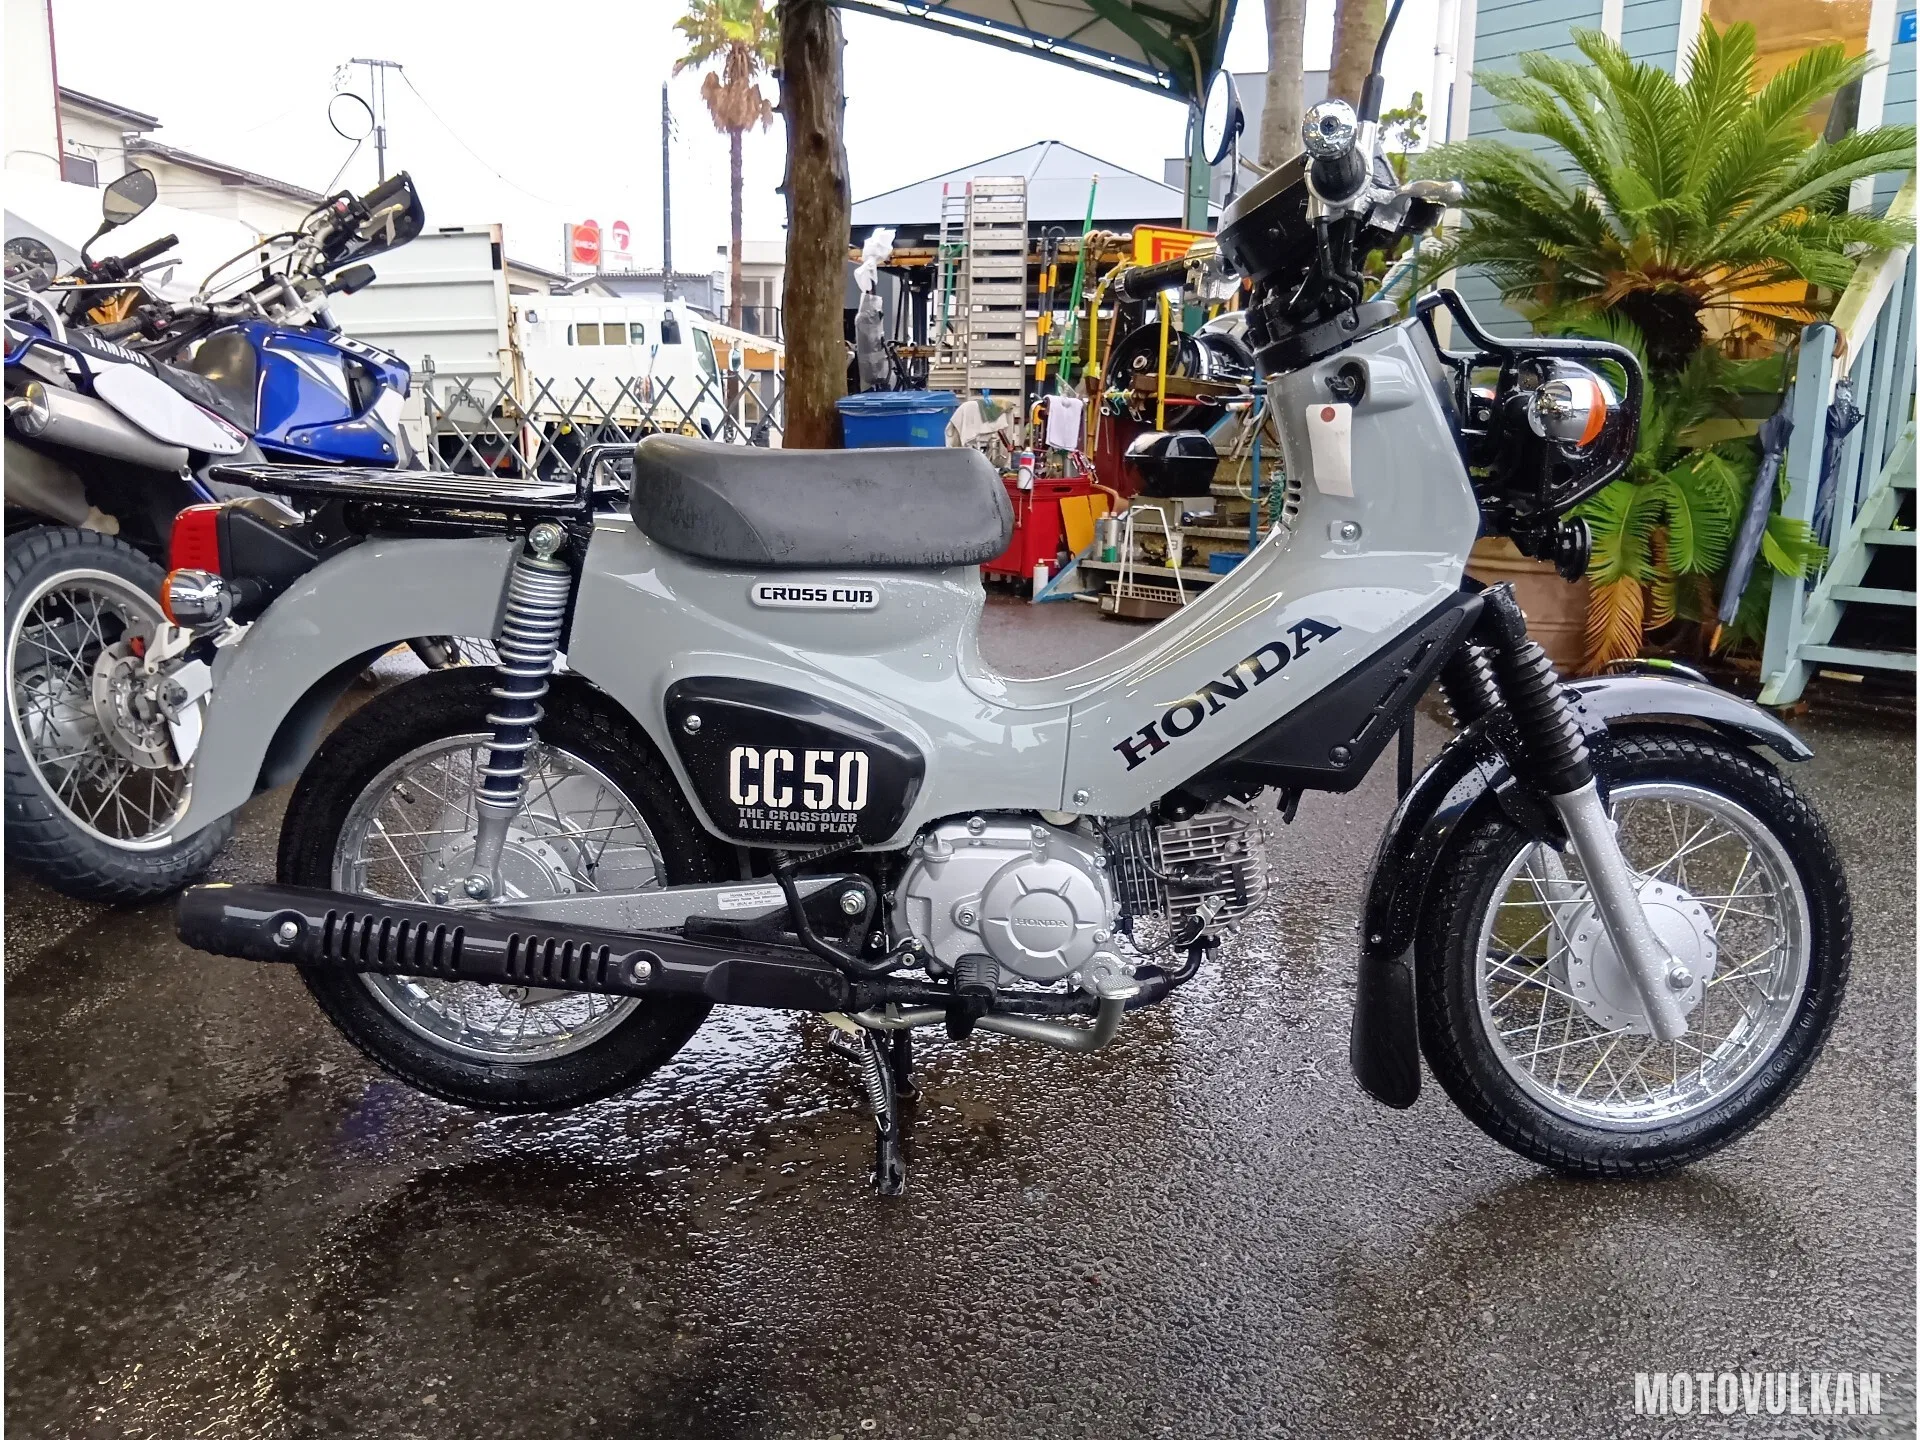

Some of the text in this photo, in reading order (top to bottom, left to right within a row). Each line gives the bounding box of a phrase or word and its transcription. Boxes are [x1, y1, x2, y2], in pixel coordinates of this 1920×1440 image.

[82, 332, 151, 367] YAMAHA
[760, 587, 873, 602] CROSS CUB
[1113, 617, 1342, 771] HONDA
[738, 807, 858, 823] THE CROSSOVER
[738, 818, 857, 833] A LIFE AND PLAY
[1015, 918, 1069, 927] HONDA
